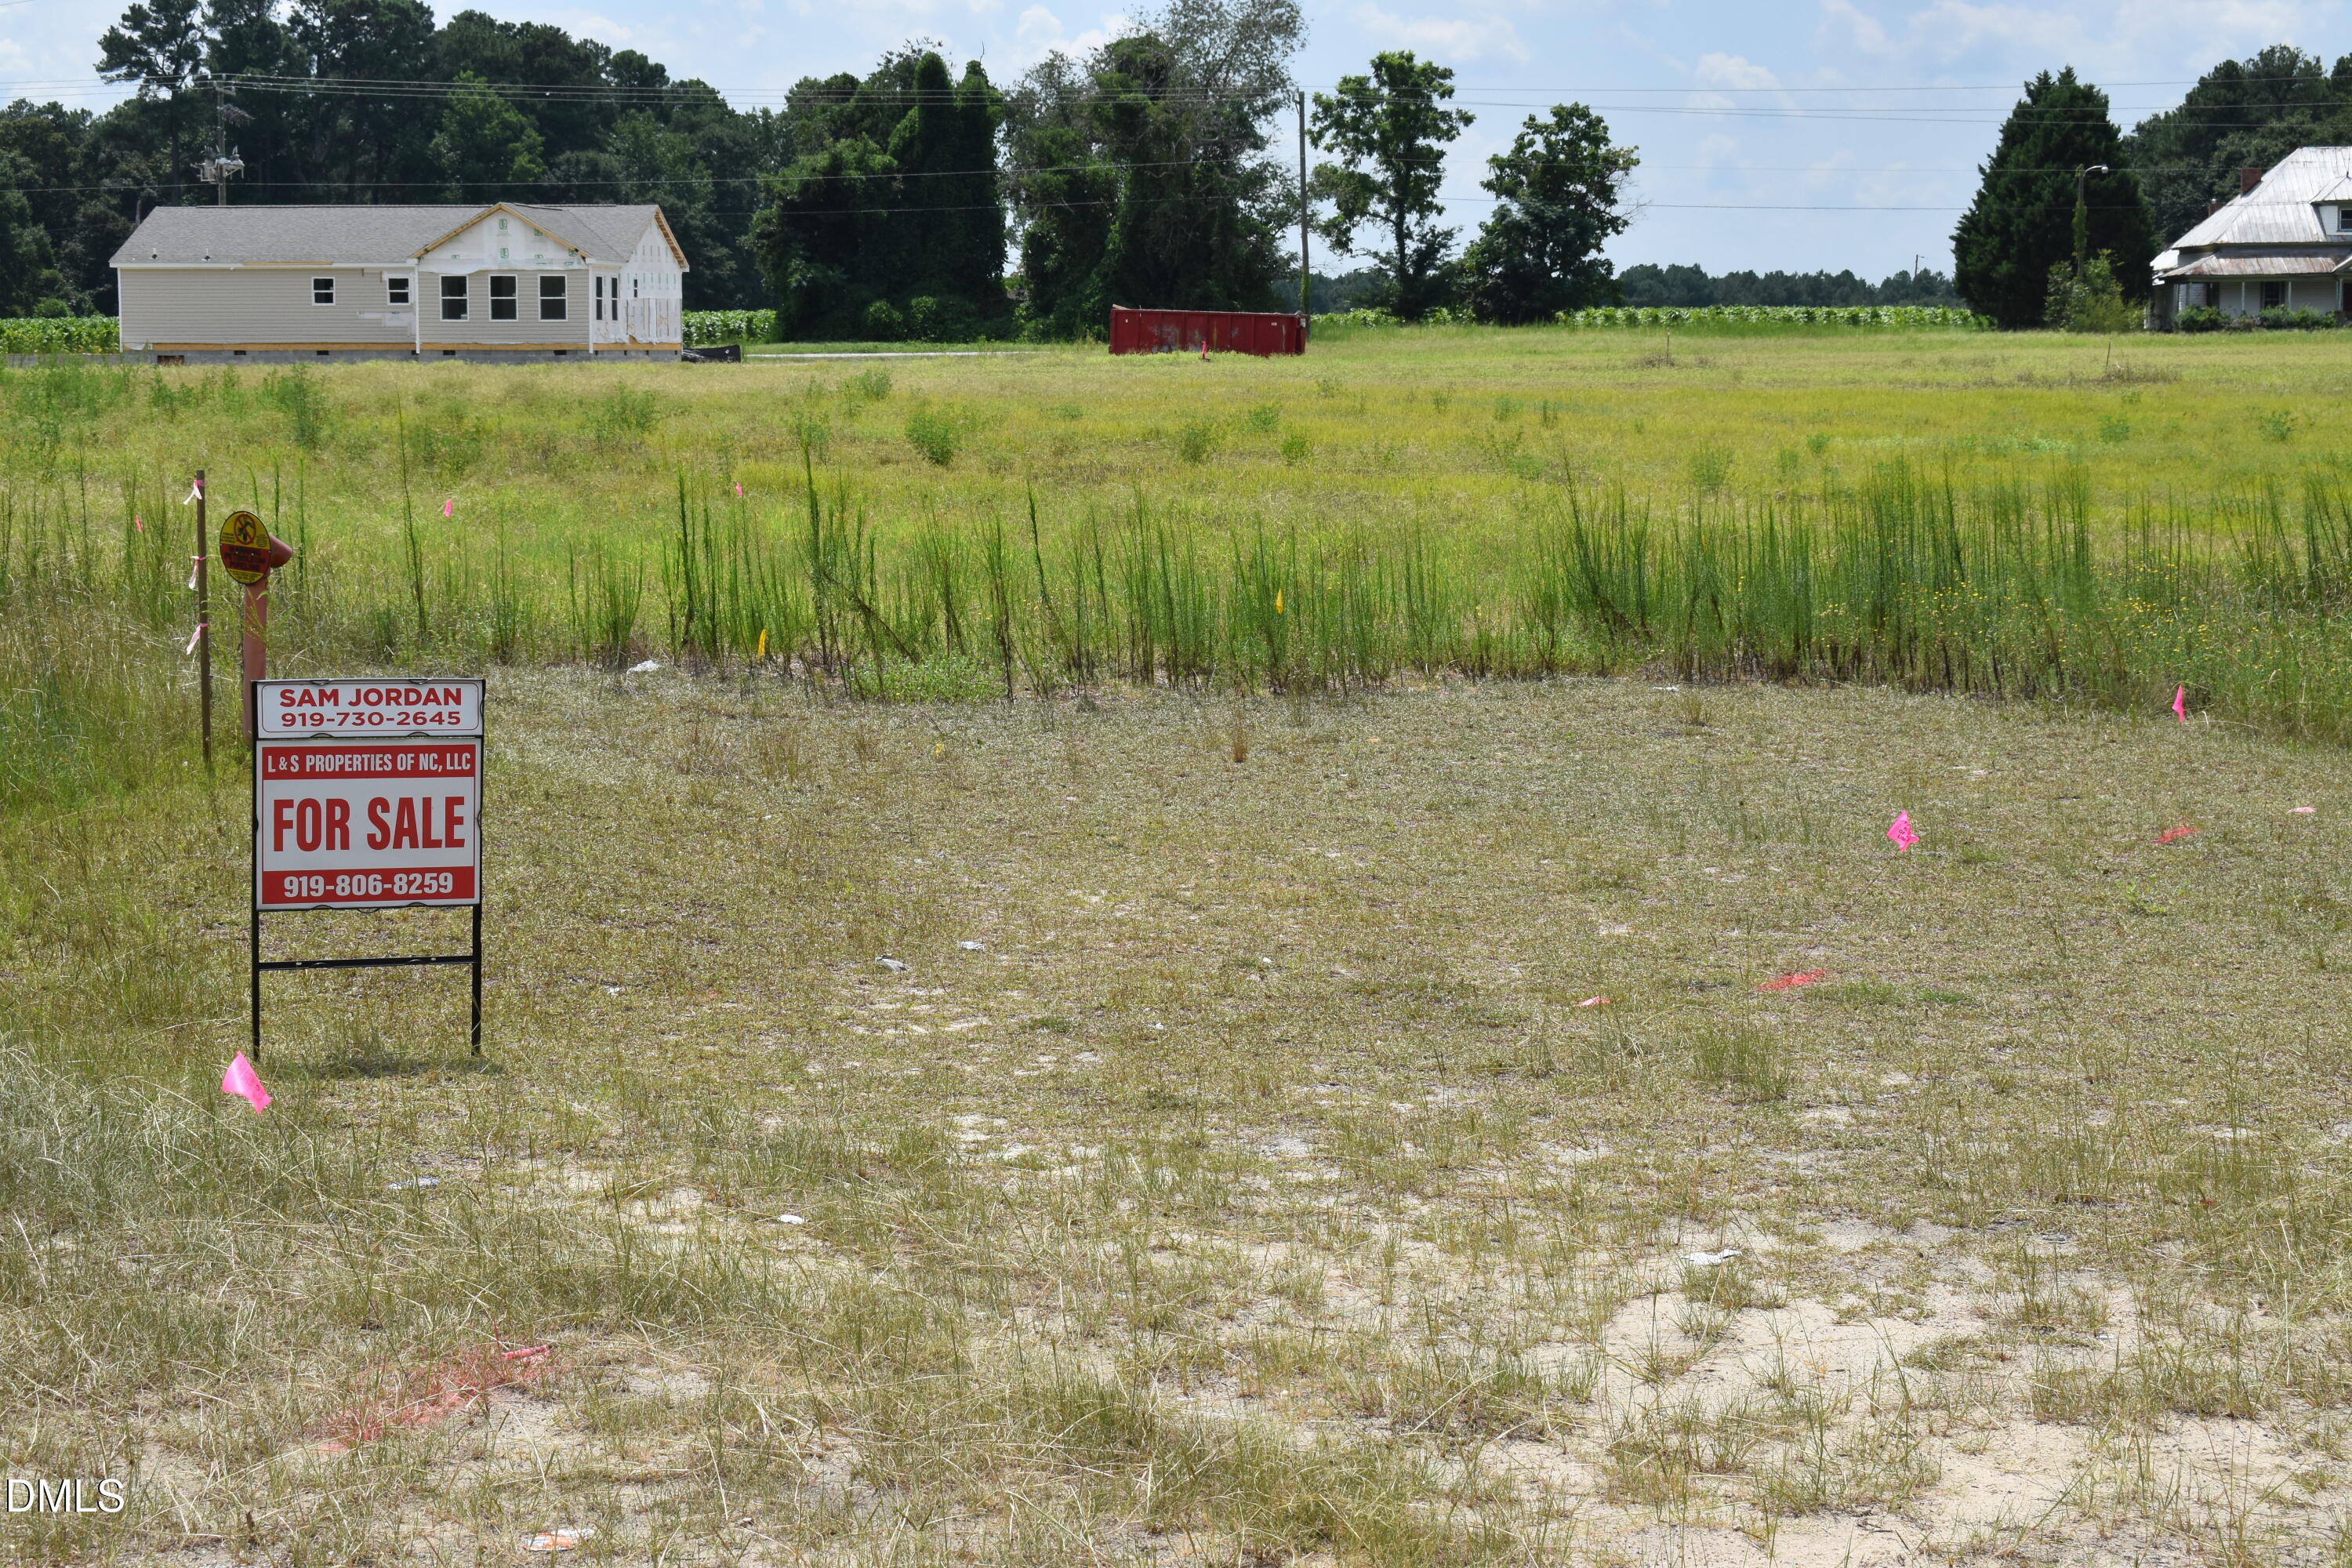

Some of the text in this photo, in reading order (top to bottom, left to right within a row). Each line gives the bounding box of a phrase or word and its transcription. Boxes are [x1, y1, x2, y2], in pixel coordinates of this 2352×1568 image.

[280, 688, 462, 707] SAM JORDAN
[281, 711, 461, 728] 919-730-2645
[267, 753, 471, 772] L & S PROPERTIES OF NC, LLC
[273, 796, 466, 851] FOR SALE
[284, 872, 453, 898] 919-806-8259
